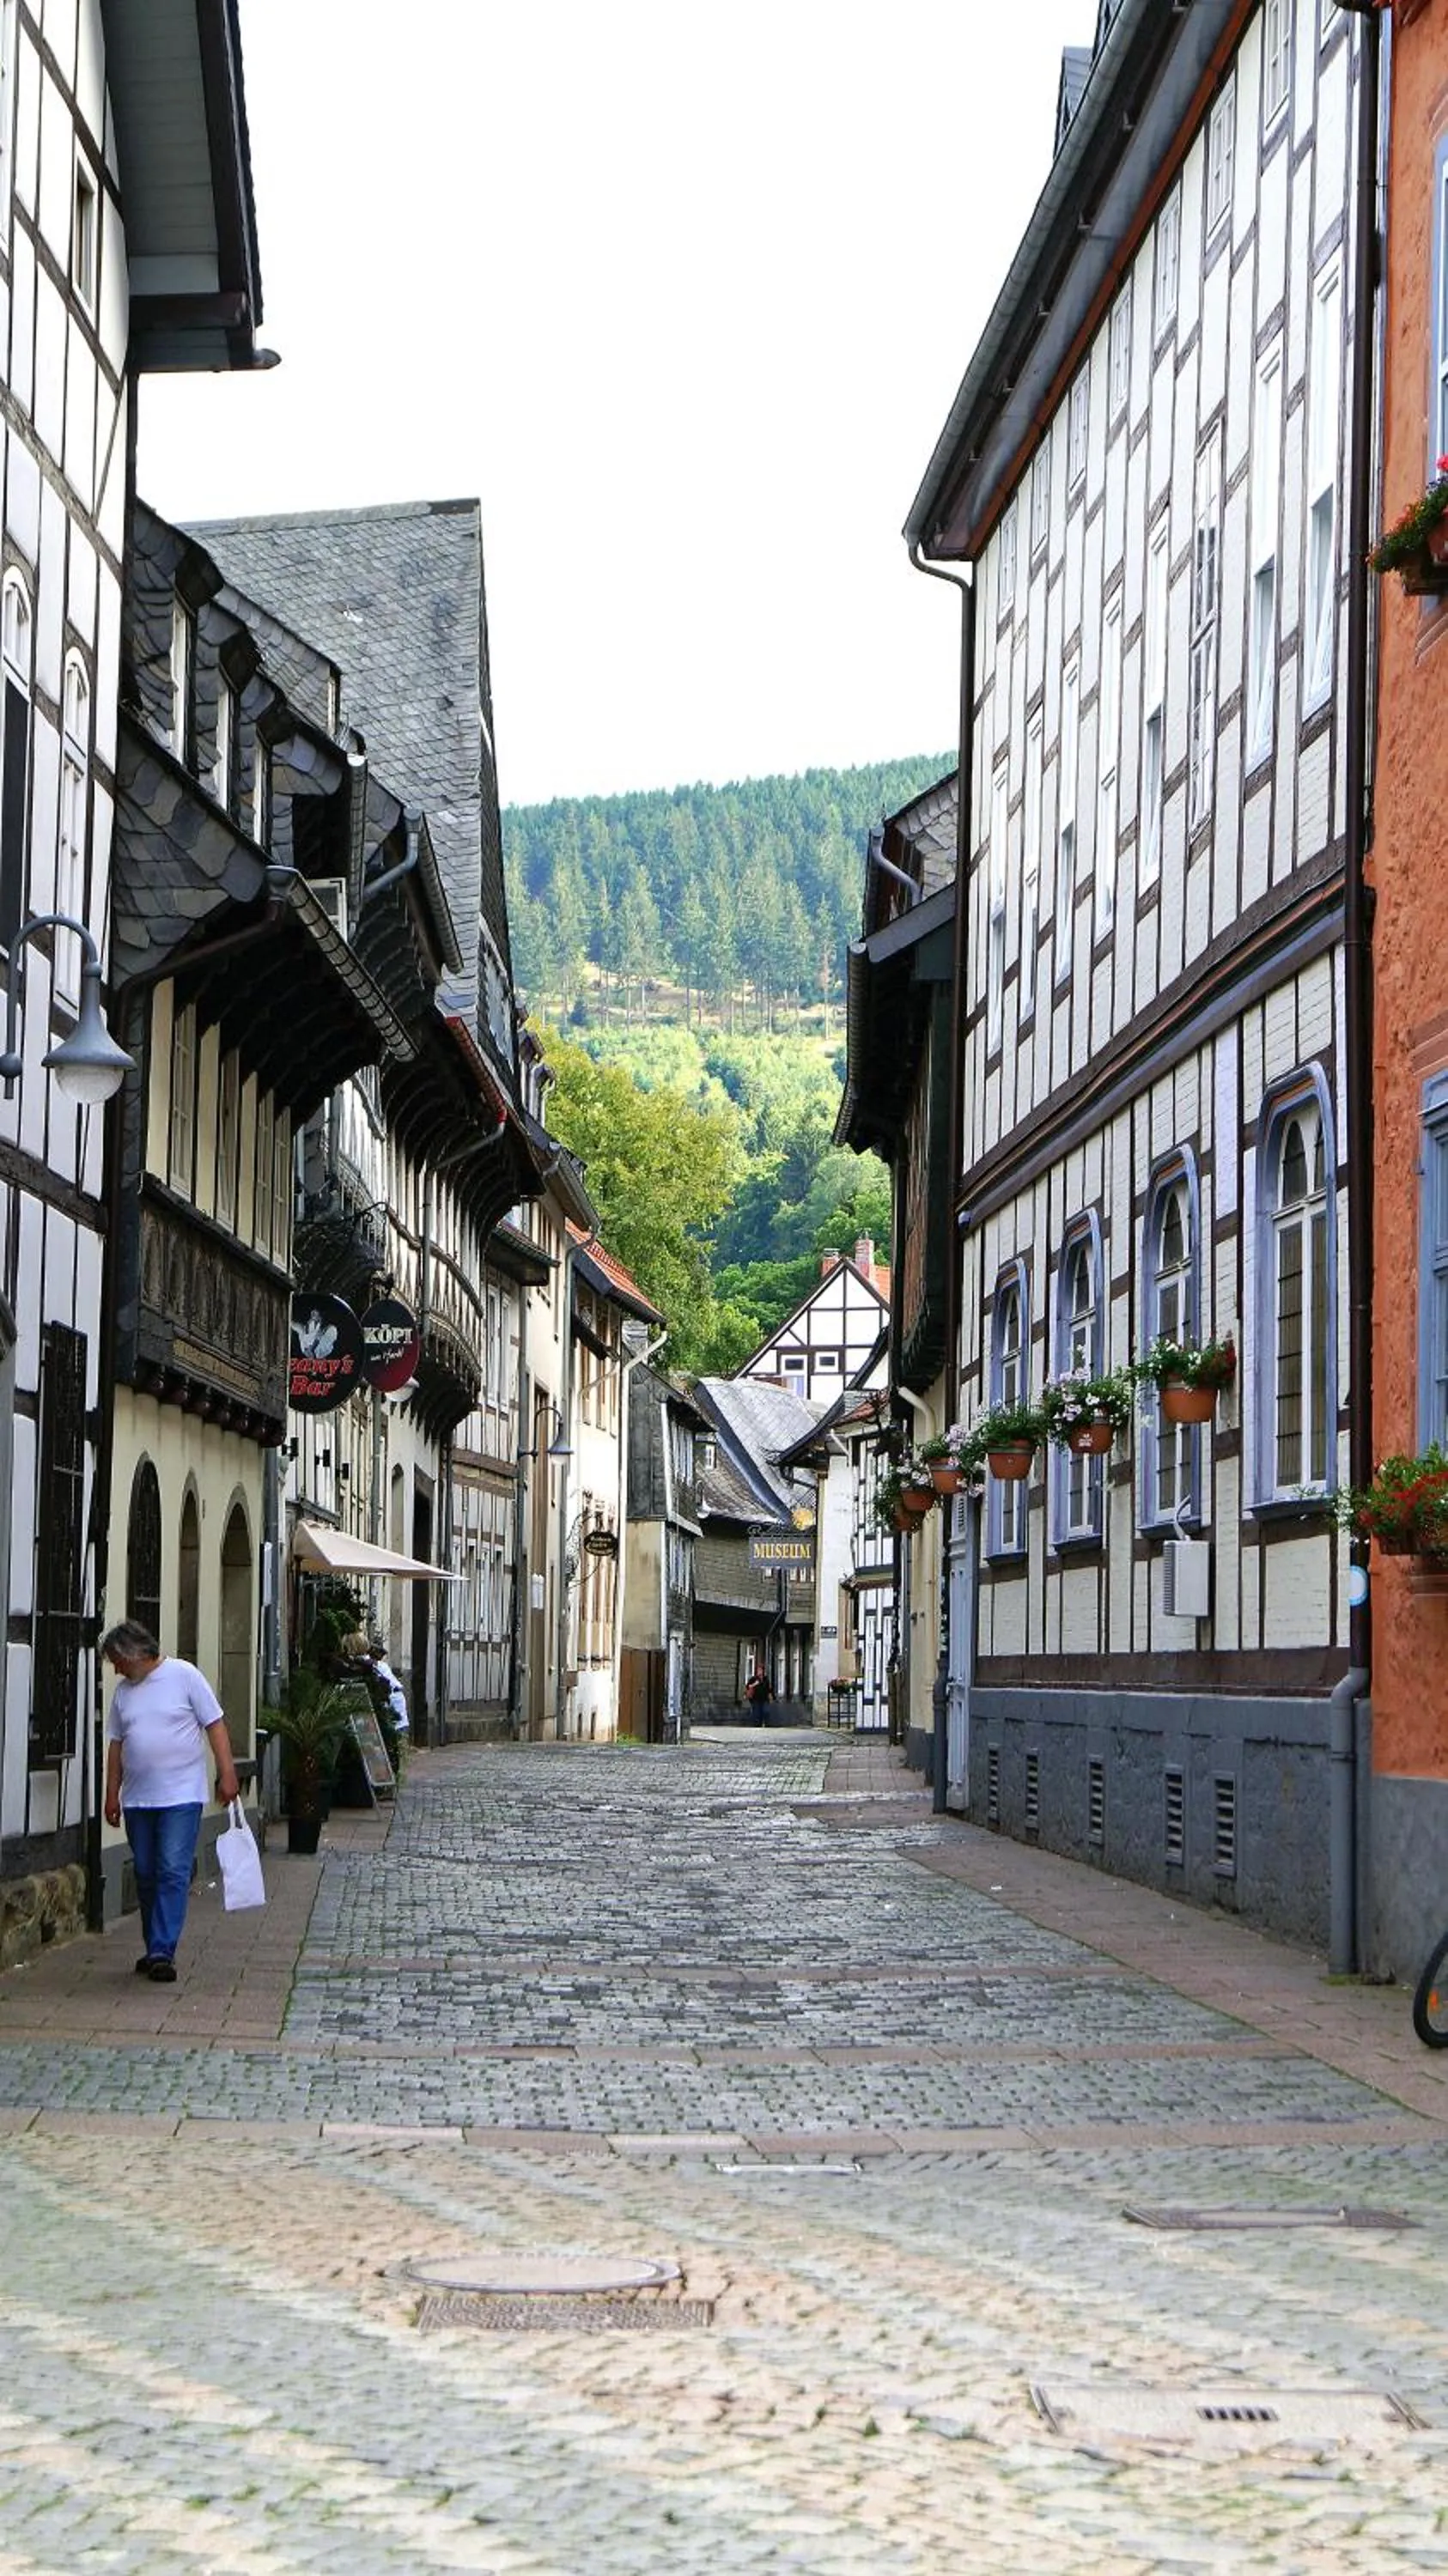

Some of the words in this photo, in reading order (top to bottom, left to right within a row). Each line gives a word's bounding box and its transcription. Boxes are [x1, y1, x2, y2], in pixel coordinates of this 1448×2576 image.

[363, 1323, 413, 1344] KÖPI
[290, 1375, 336, 1396] Bar
[753, 1542, 812, 1558] MUSEUM
